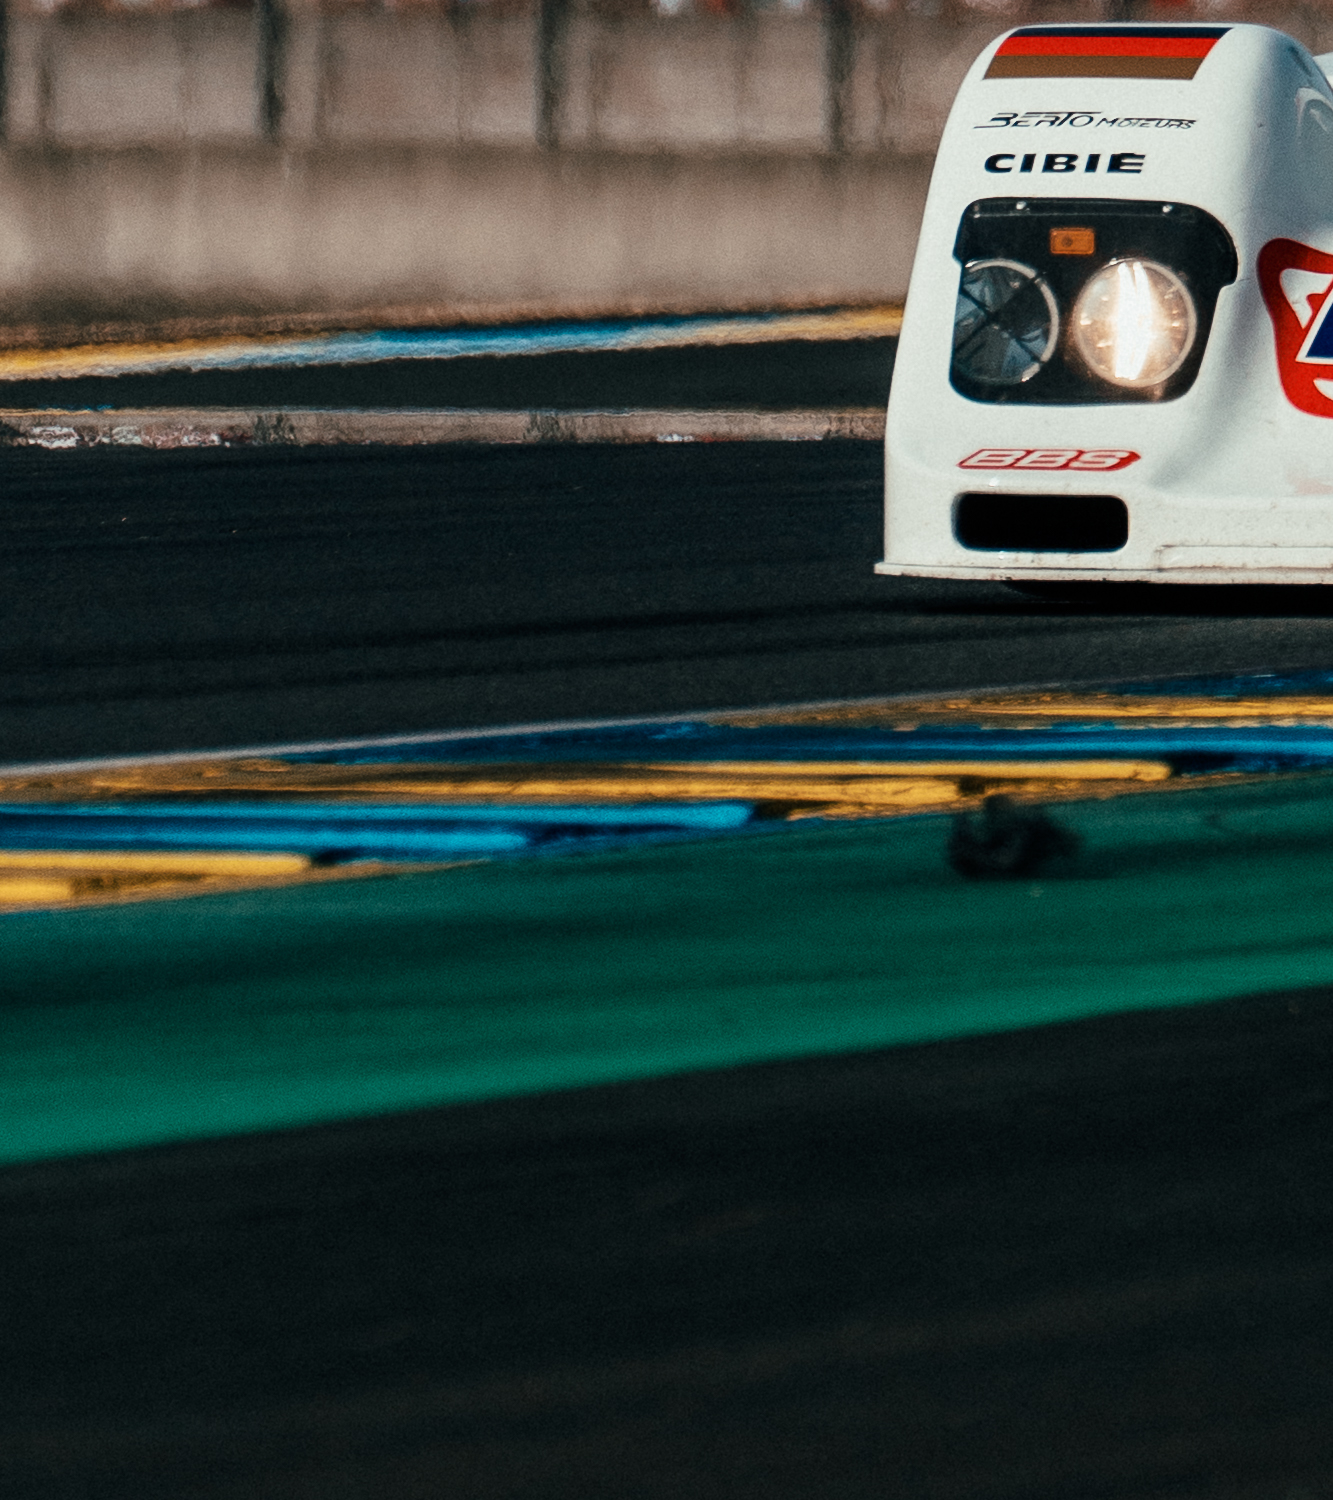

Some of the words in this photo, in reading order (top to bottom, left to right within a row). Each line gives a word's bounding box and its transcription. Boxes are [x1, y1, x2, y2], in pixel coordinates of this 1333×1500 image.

[973, 111, 1102, 129] BERTO
[1095, 117, 1197, 129] MOTEURS
[957, 449, 1141, 472] BBS
